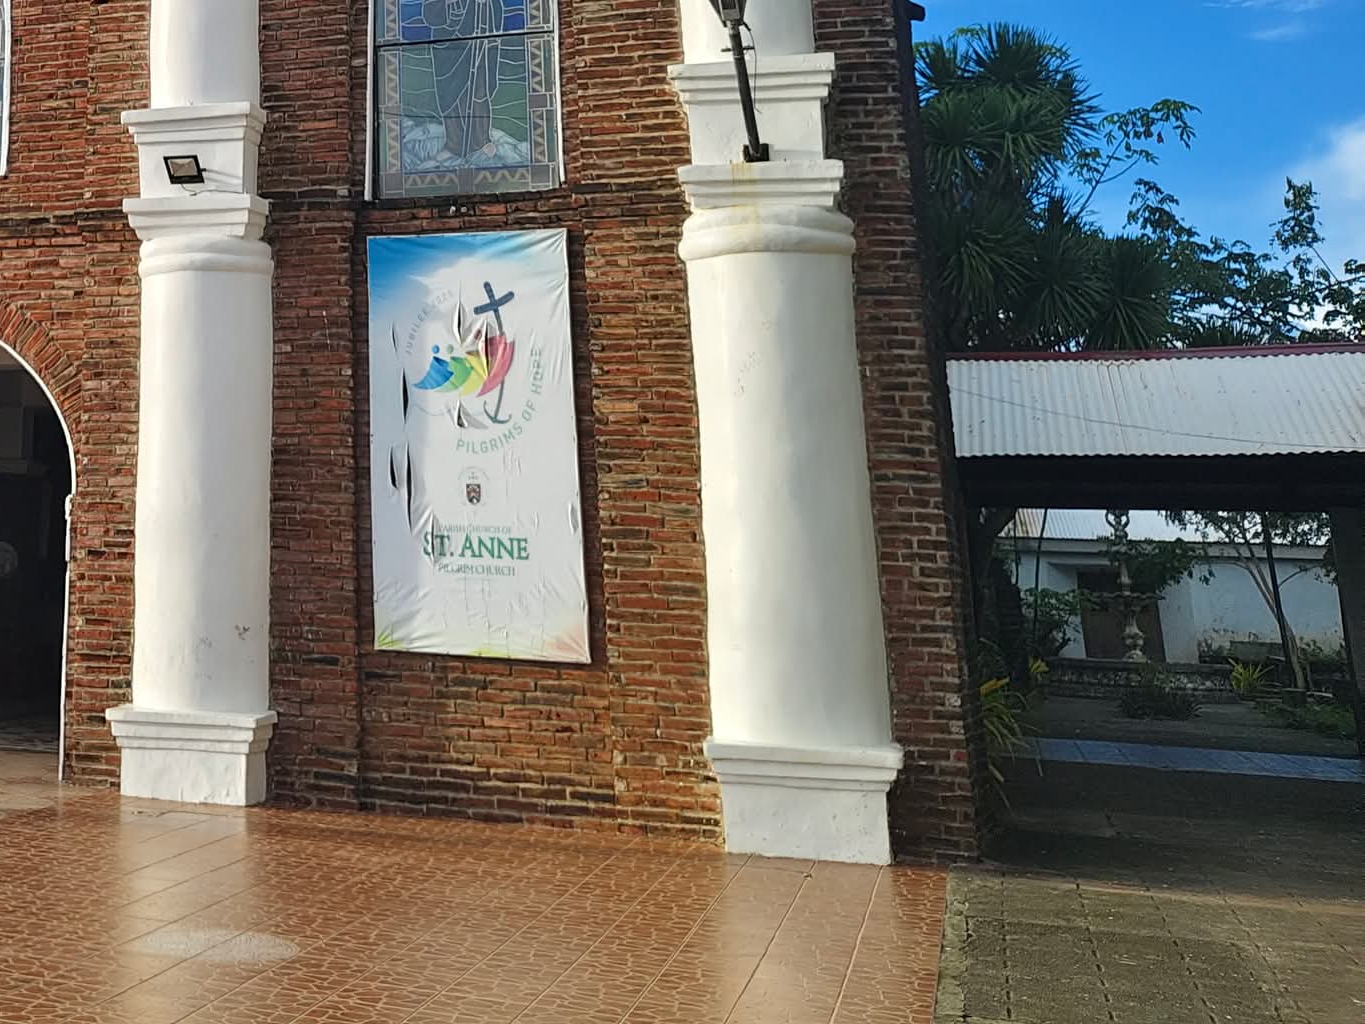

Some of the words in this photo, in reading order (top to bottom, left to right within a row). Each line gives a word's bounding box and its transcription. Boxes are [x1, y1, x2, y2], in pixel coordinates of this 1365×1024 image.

[456, 423, 523, 454] PILGRIMS
[521, 400, 537, 422] OF
[423, 532, 454, 557] ST.
[459, 533, 530, 560] ANNE
[475, 564, 515, 576] CHURCH
